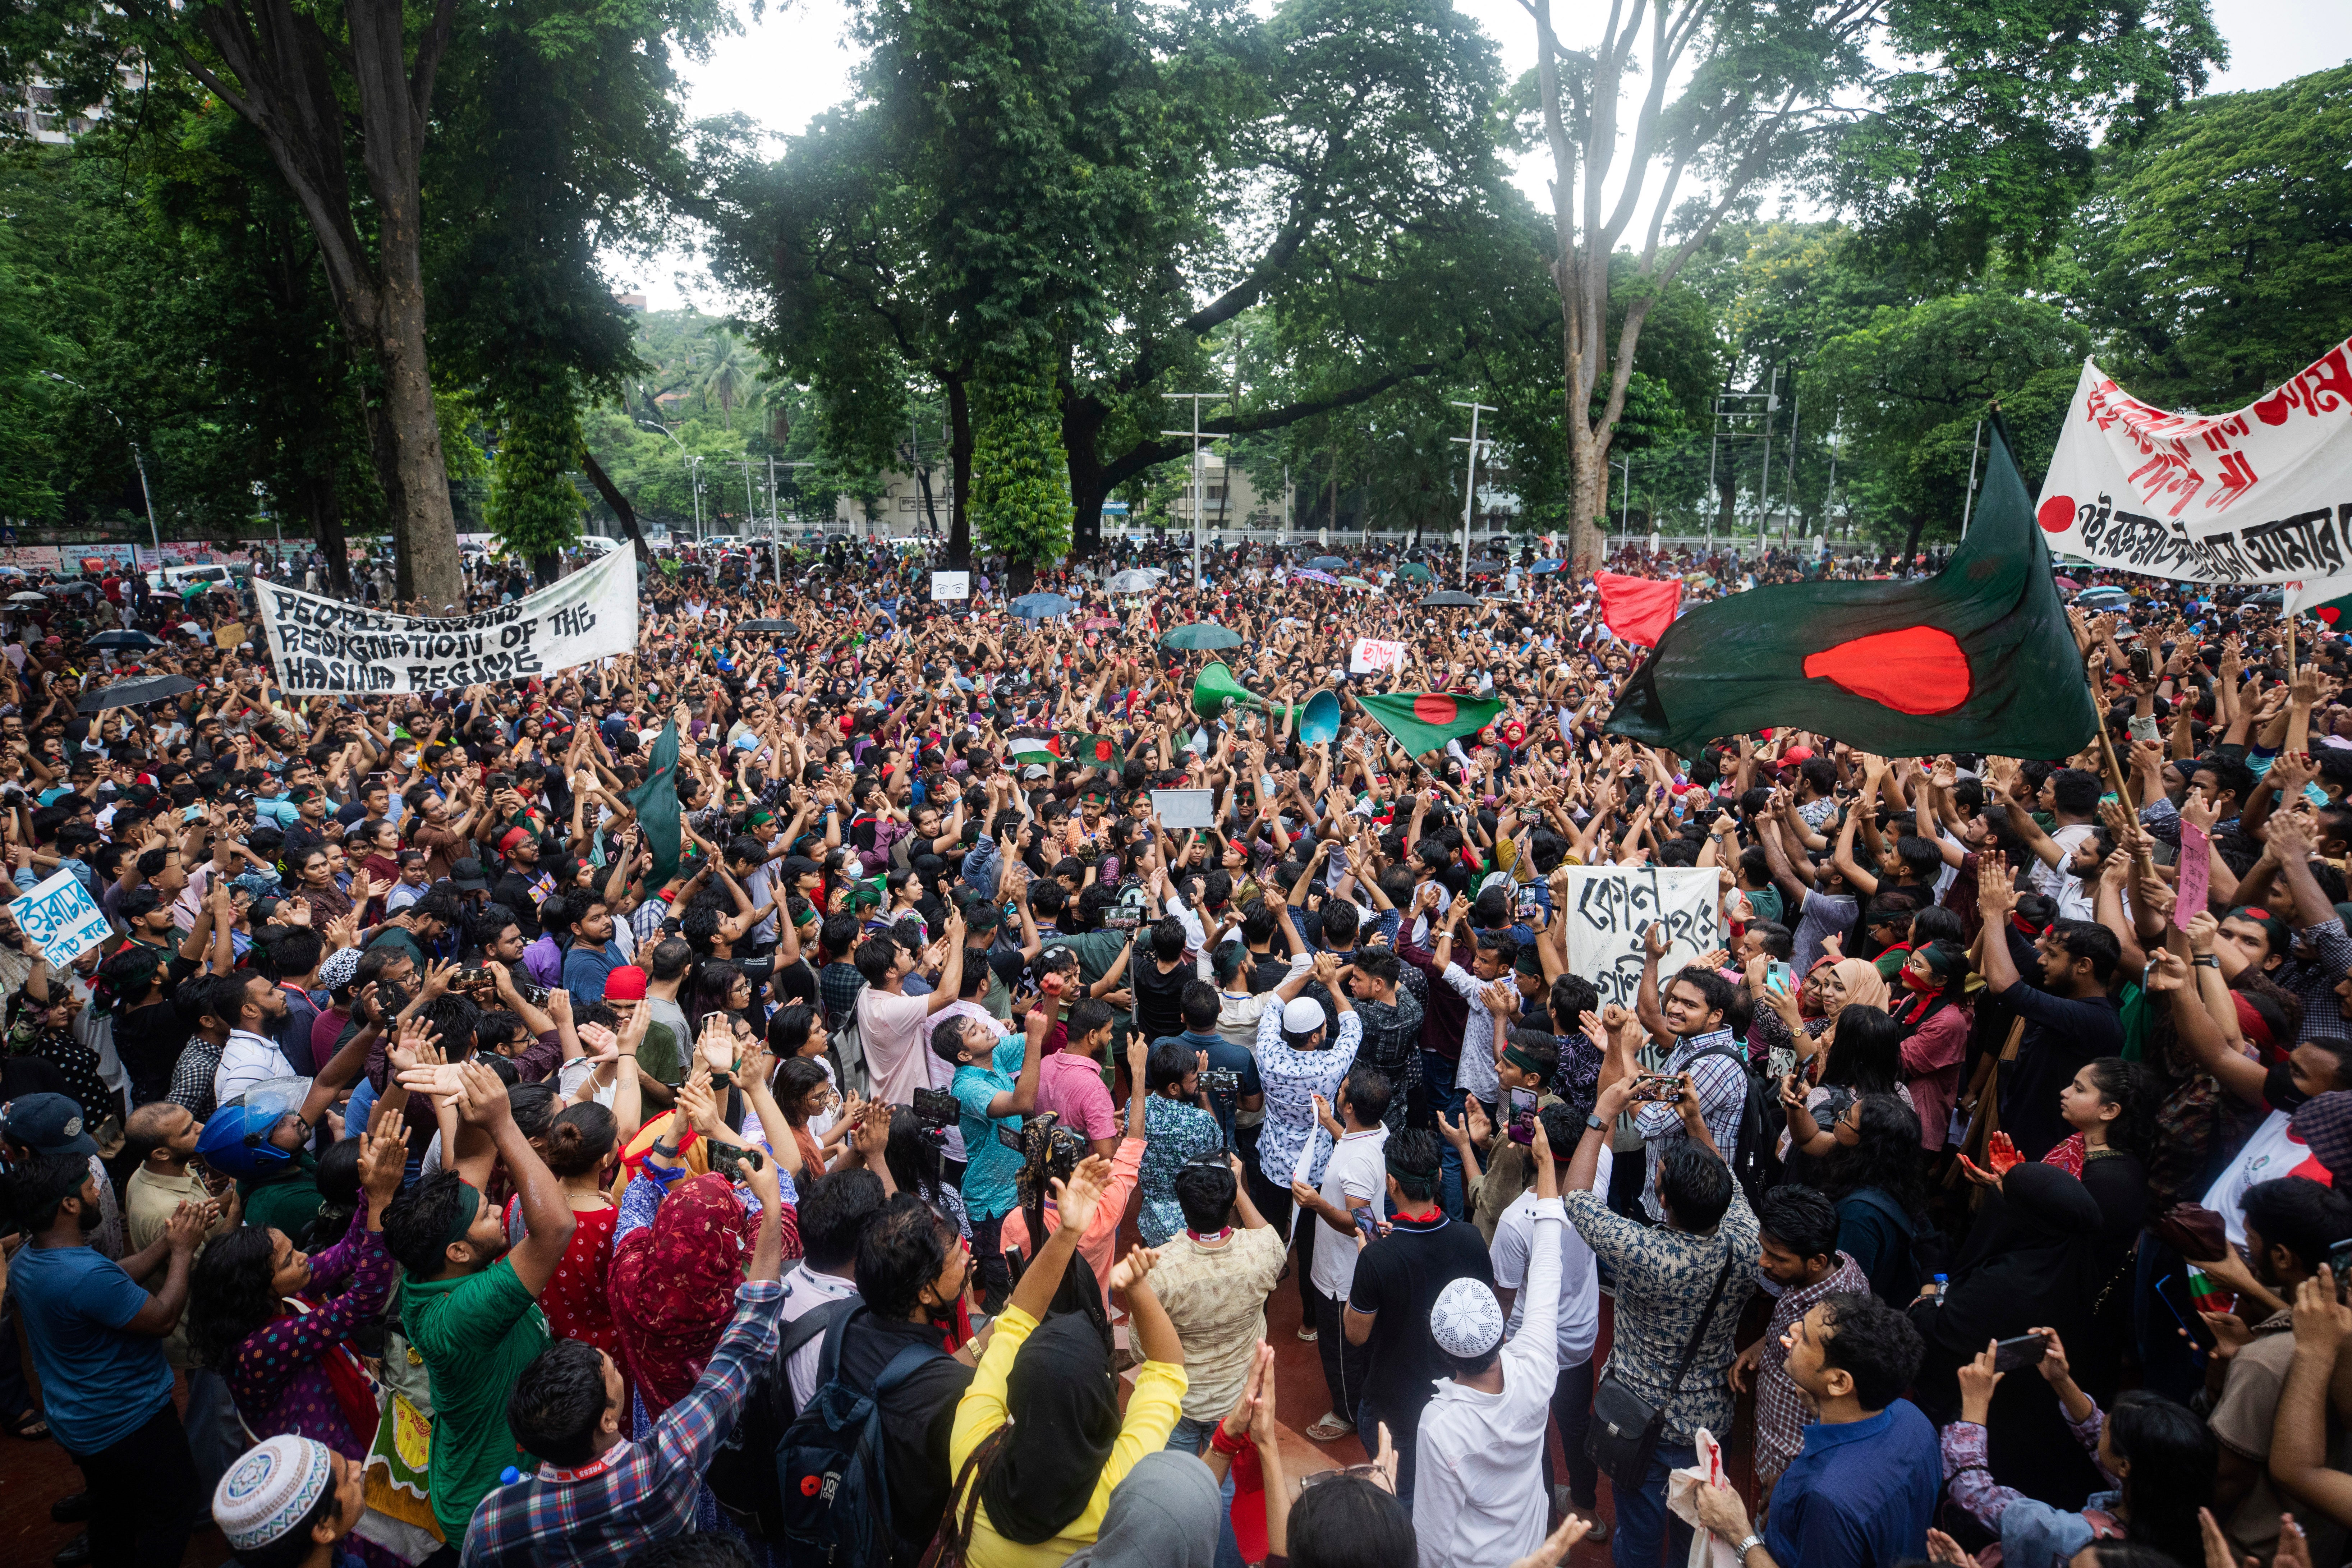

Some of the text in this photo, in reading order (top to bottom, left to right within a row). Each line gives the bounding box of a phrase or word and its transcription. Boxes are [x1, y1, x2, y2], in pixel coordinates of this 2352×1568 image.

[2078, 490, 2112, 556] এই
[2241, 507, 2344, 577] আমার
[272, 590, 523, 634] PEOPLE DEMAND
[278, 625, 484, 662] RESIGNATION
[500, 618, 539, 649] OF
[547, 601, 595, 636] THE
[284, 646, 543, 691] HASINA REGIME
[1578, 868, 1661, 933] কোন
[44, 917, 107, 967] নিপাত যাক
[579, 1462, 602, 1477] PRESS
